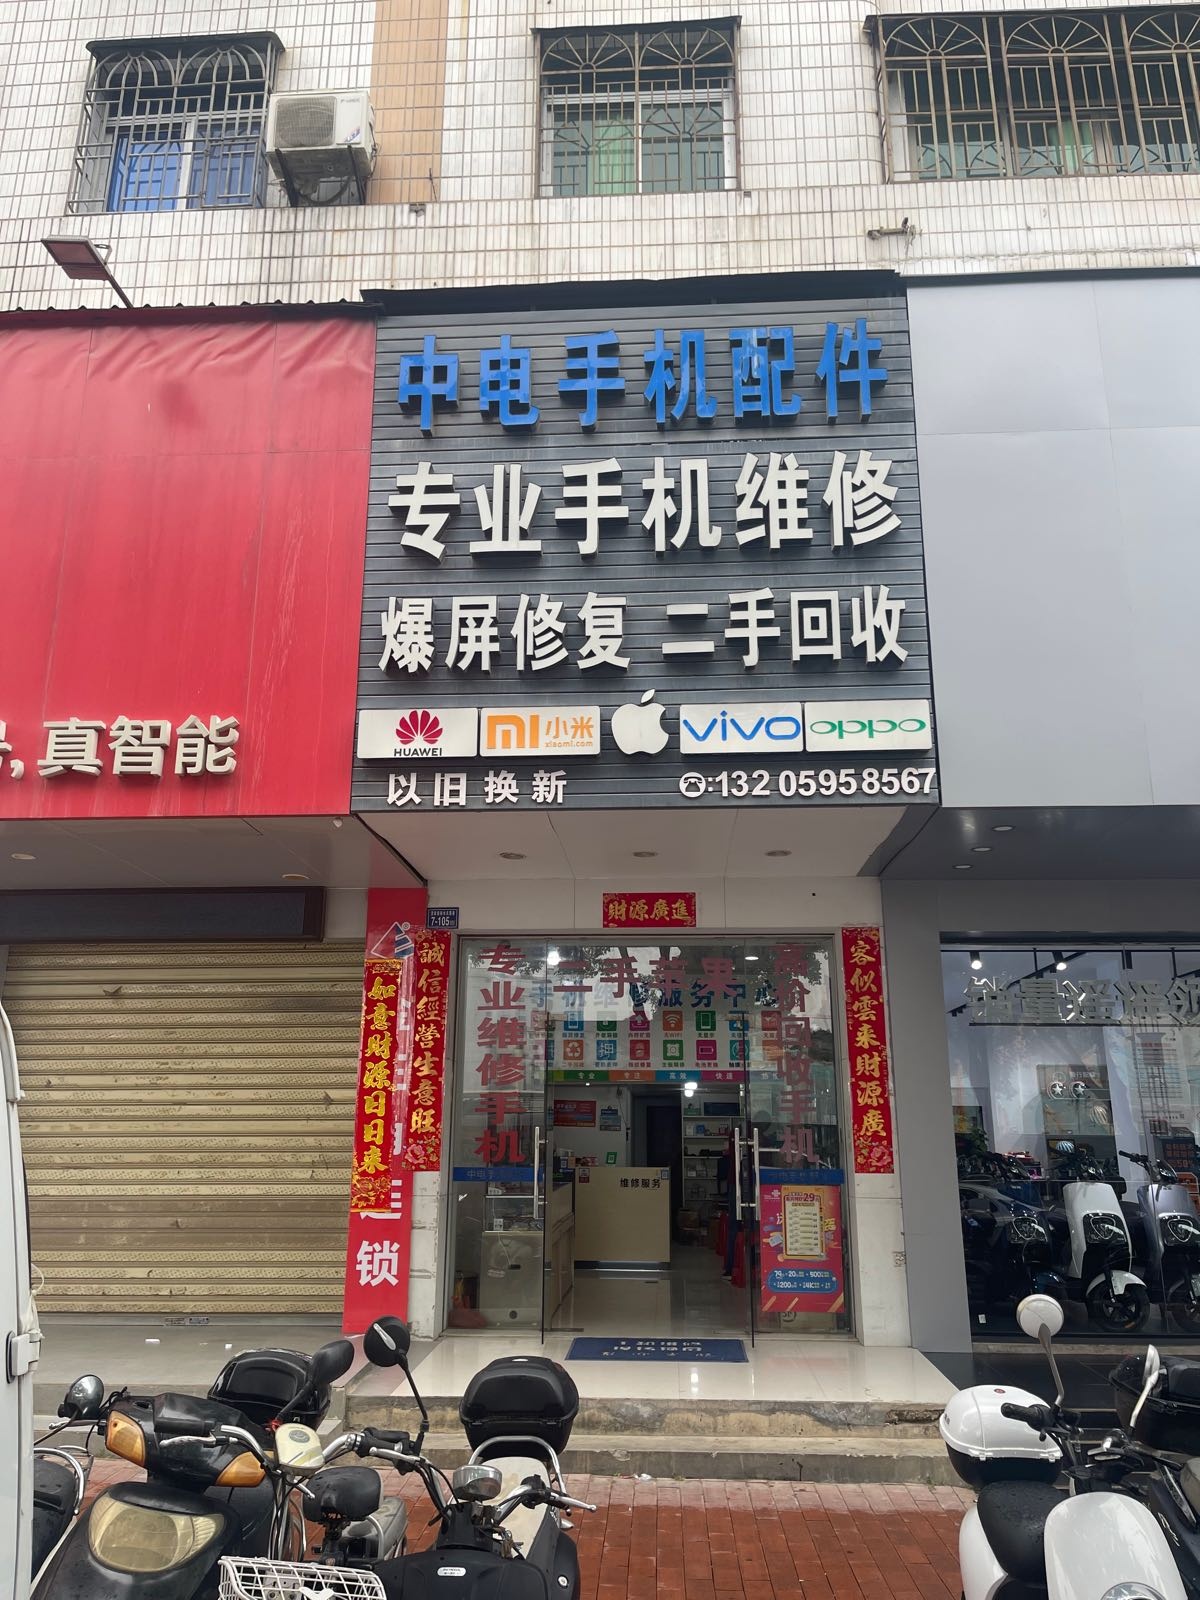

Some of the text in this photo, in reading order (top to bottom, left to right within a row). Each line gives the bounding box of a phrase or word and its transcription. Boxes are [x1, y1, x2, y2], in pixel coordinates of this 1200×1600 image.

[398, 317, 888, 436] 中电手机配件
[388, 449, 902, 562] 专业手机维修
[378, 584, 909, 673] 爆屏修复 二手回收
[544, 738, 593, 748] xiaomi.com
[545, 715, 594, 739] 小米
[682, 710, 801, 742] vivo
[0, 714, 241, 780] ,真智能
[393, 747, 443, 757] HUAWEI
[387, 769, 568, 807] 以旧换新
[608, 898, 691, 922] 財源廣進
[473, 943, 527, 1164] 专业维修手机
[619, 1178, 662, 1189] 维修服务
